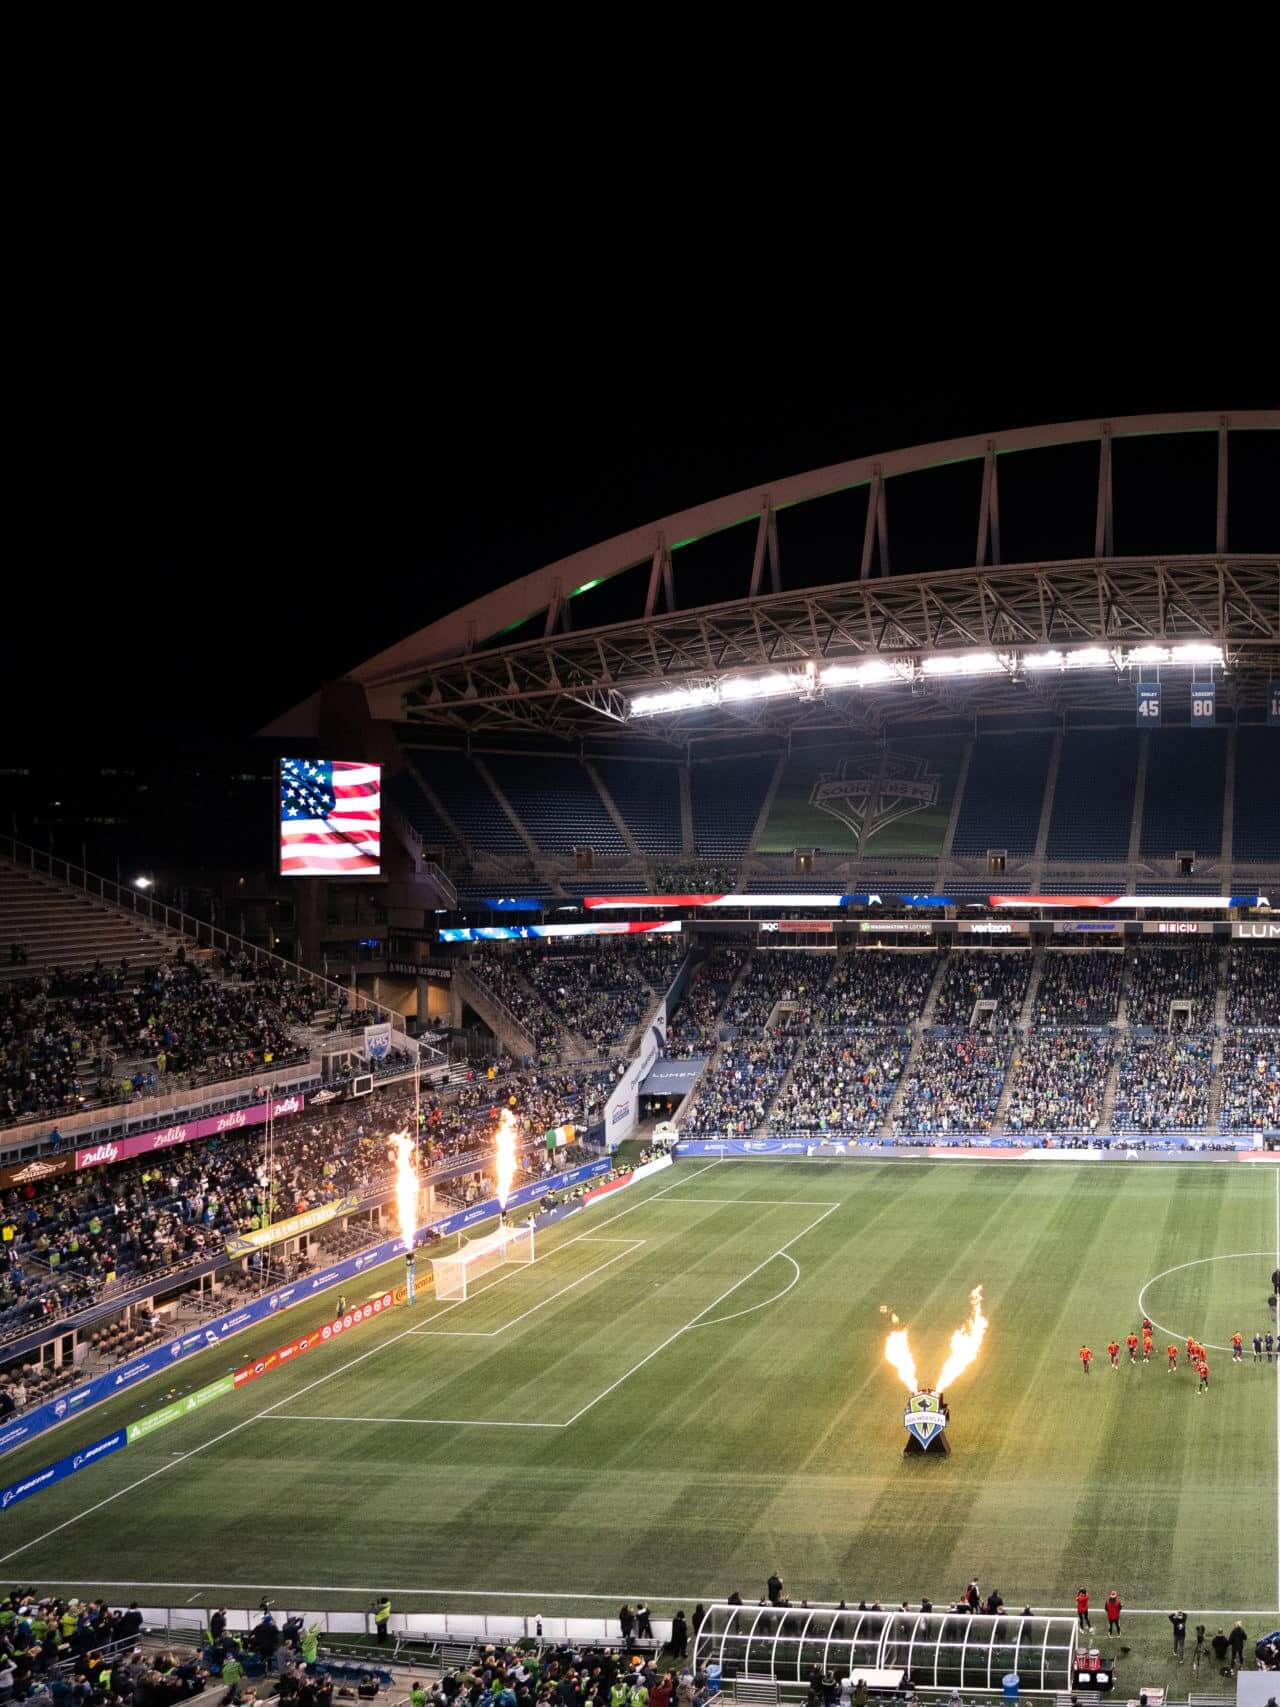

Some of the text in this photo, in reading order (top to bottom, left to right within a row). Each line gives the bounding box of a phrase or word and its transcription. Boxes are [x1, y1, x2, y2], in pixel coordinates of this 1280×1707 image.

[1138, 700, 1159, 717] 45
[1193, 700, 1213, 717] 80
[971, 922, 1011, 933] verizon
[216, 1110, 247, 1131] zulily
[153, 1126, 187, 1148] zulily
[81, 1143, 119, 1166] zulily
